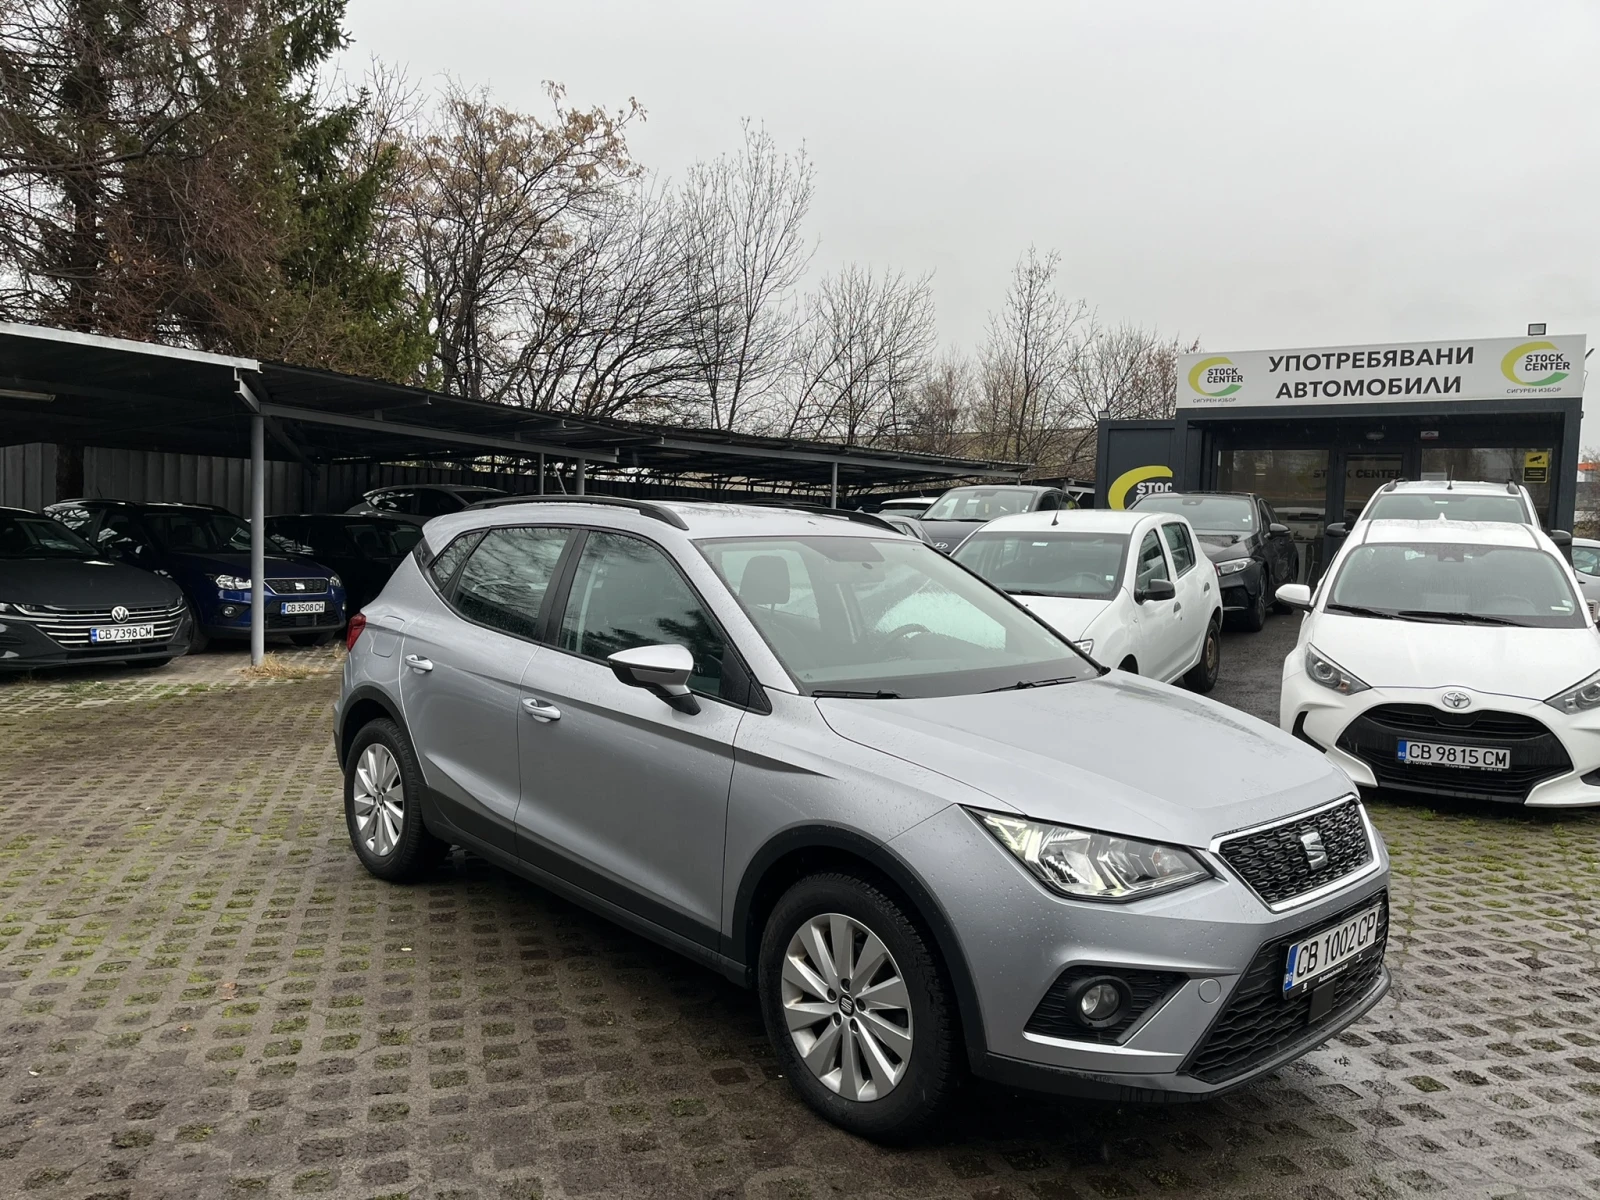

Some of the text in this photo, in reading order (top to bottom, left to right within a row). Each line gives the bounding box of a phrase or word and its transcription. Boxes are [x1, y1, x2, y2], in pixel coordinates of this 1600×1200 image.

[1269, 347, 1474, 372] УПОТРЕБЯВАНИ
[1526, 353, 1564, 362] STOCK
[1525, 361, 1570, 371] CENTER
[1207, 368, 1238, 376] STOCK
[1207, 375, 1243, 383] CENTER
[1275, 376, 1461, 399] АВТОМОБИЛИ
[1313, 469, 1352, 479] STK
[1136, 482, 1173, 494] STOC
[297, 603, 313, 612] 3508
[113, 628, 138, 639] 7398
[1436, 746, 1479, 765] 9815
[1324, 921, 1357, 966] 1002
